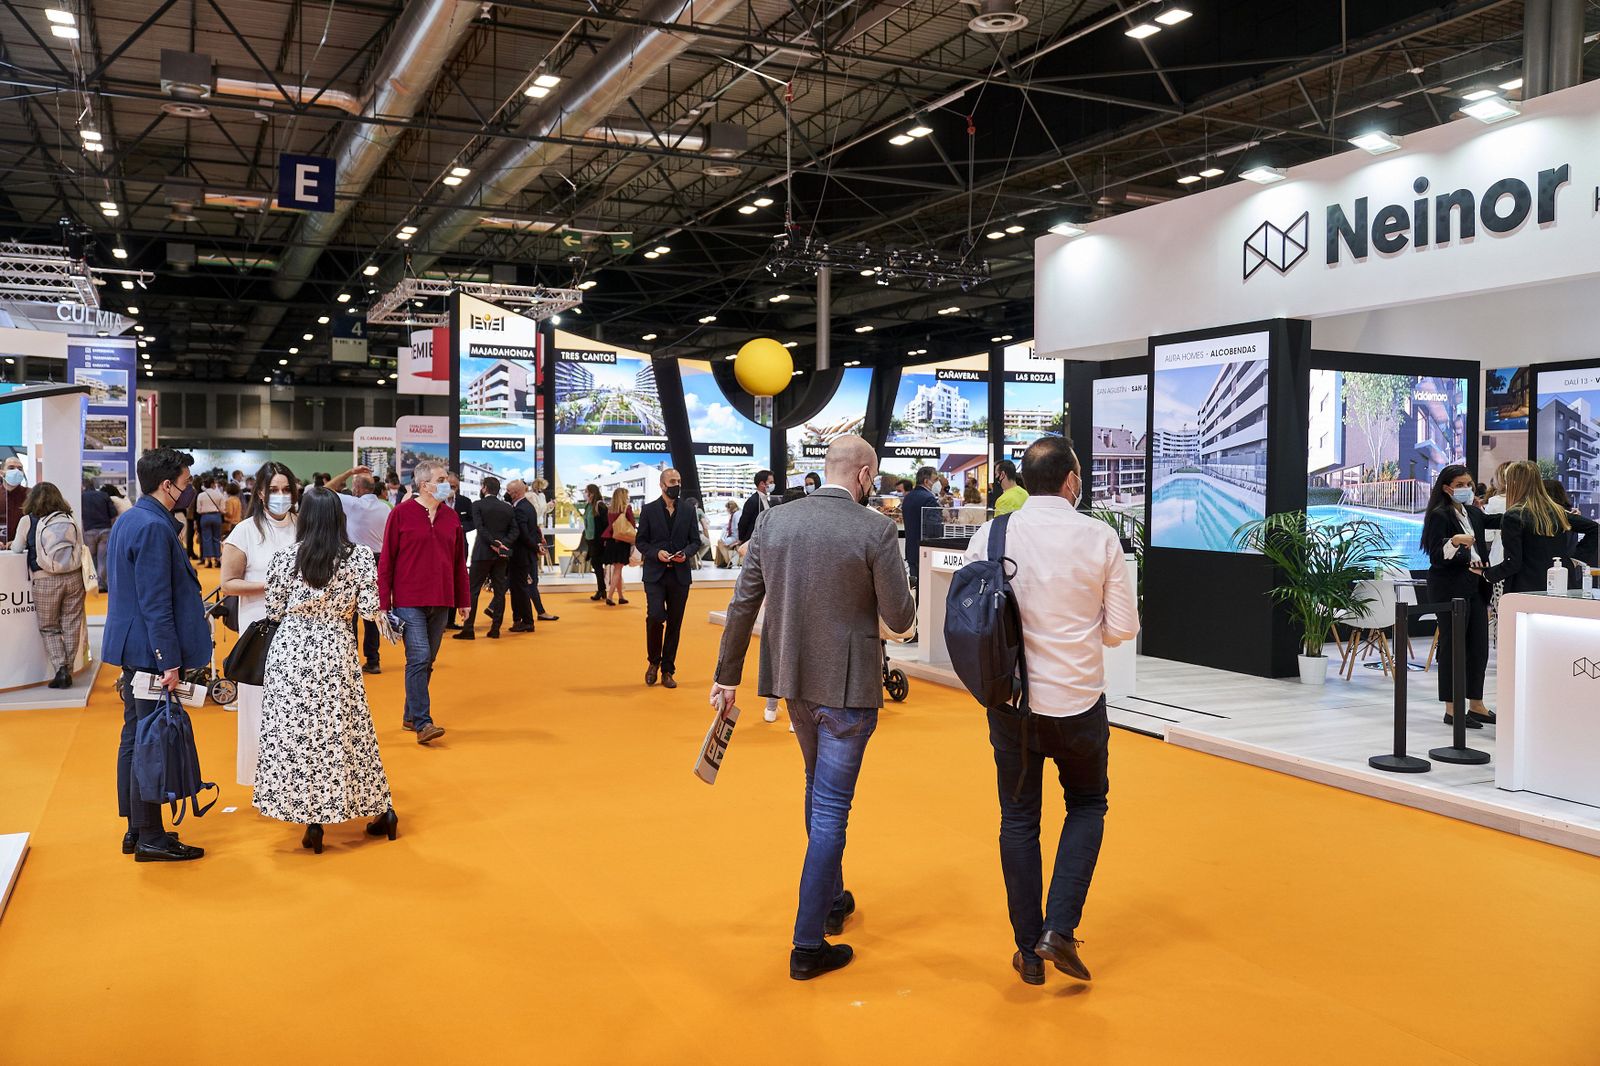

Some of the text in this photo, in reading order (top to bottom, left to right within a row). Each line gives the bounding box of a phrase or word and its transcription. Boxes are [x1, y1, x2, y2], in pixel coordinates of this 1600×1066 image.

[295, 163, 320, 203] E
[1326, 163, 1569, 265] Neinor
[57, 304, 122, 330] CULMIA
[351, 321, 363, 336] 4
[470, 346, 535, 358] MAJADAHONDA
[560, 351, 616, 362] TRES CANTOS
[1165, 344, 1257, 363] AURA HOMES ALCOBENDAS
[938, 370, 980, 380] CAÑAVERAL
[1015, 373, 1054, 382] LAS ROZAS
[1413, 390, 1448, 402] Valdemoro
[481, 439, 523, 449] POZUELO
[614, 442, 667, 451] TRES CANTOS
[708, 445, 748, 454] ESTEPONA
[895, 447, 937, 457] CAÑAVERAL
[943, 555, 963, 567] AURA
